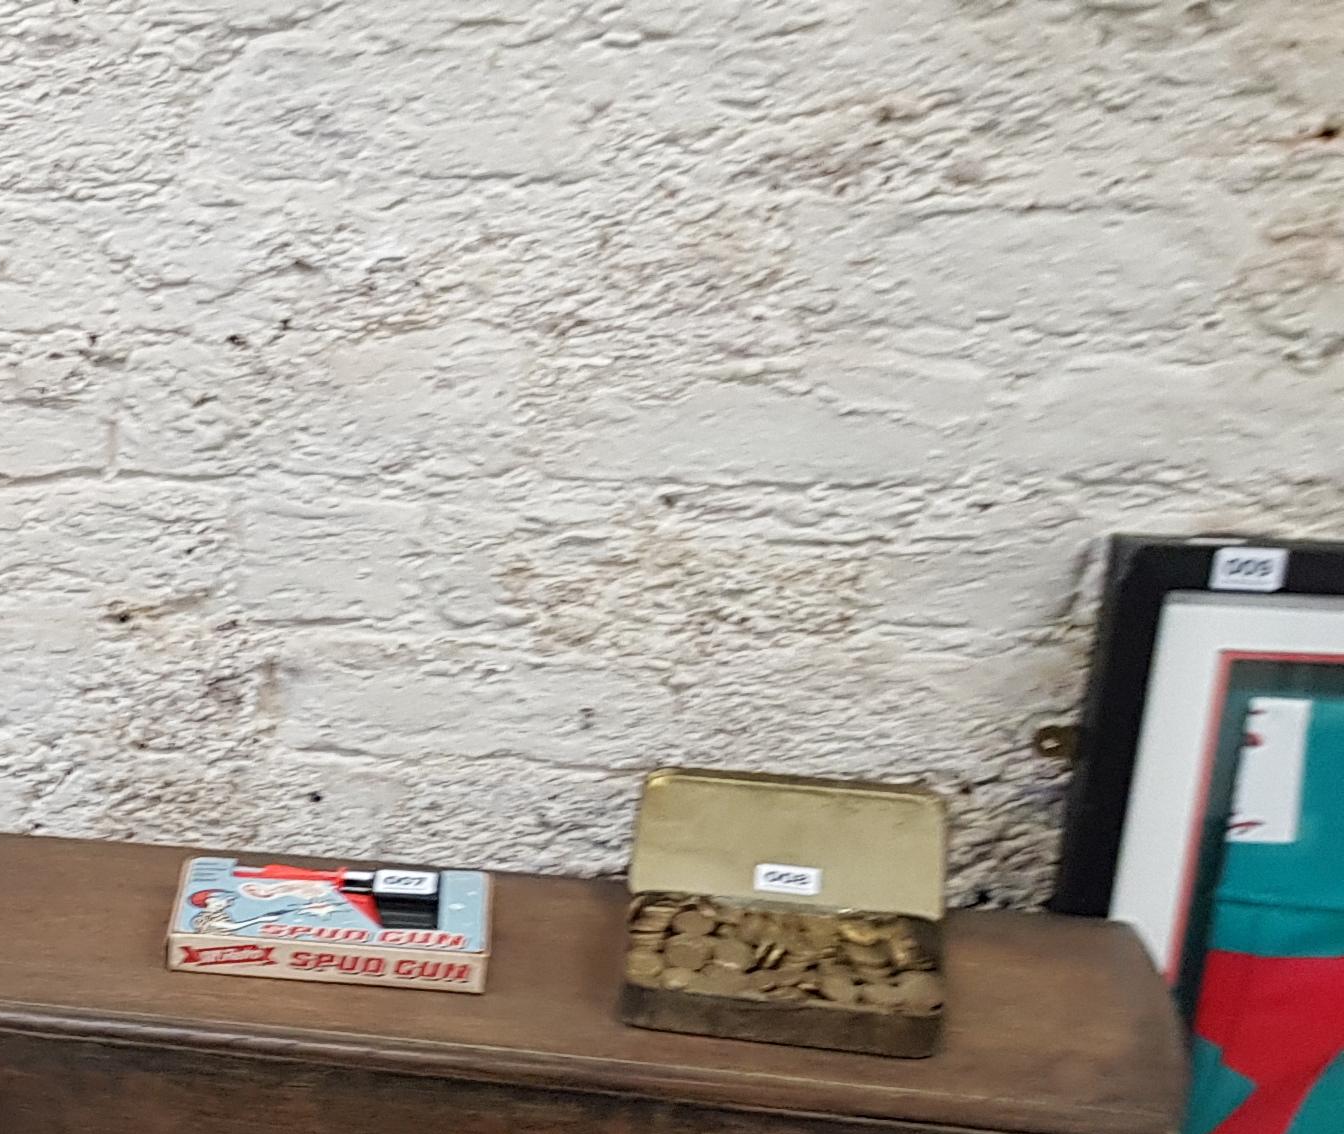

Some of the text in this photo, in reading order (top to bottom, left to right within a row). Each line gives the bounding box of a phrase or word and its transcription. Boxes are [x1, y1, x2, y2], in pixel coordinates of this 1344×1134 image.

[383, 876, 428, 887] 007
[259, 924, 468, 949] SPUD GUN
[289, 950, 386, 976] SPUD
[393, 958, 472, 983] GUN
